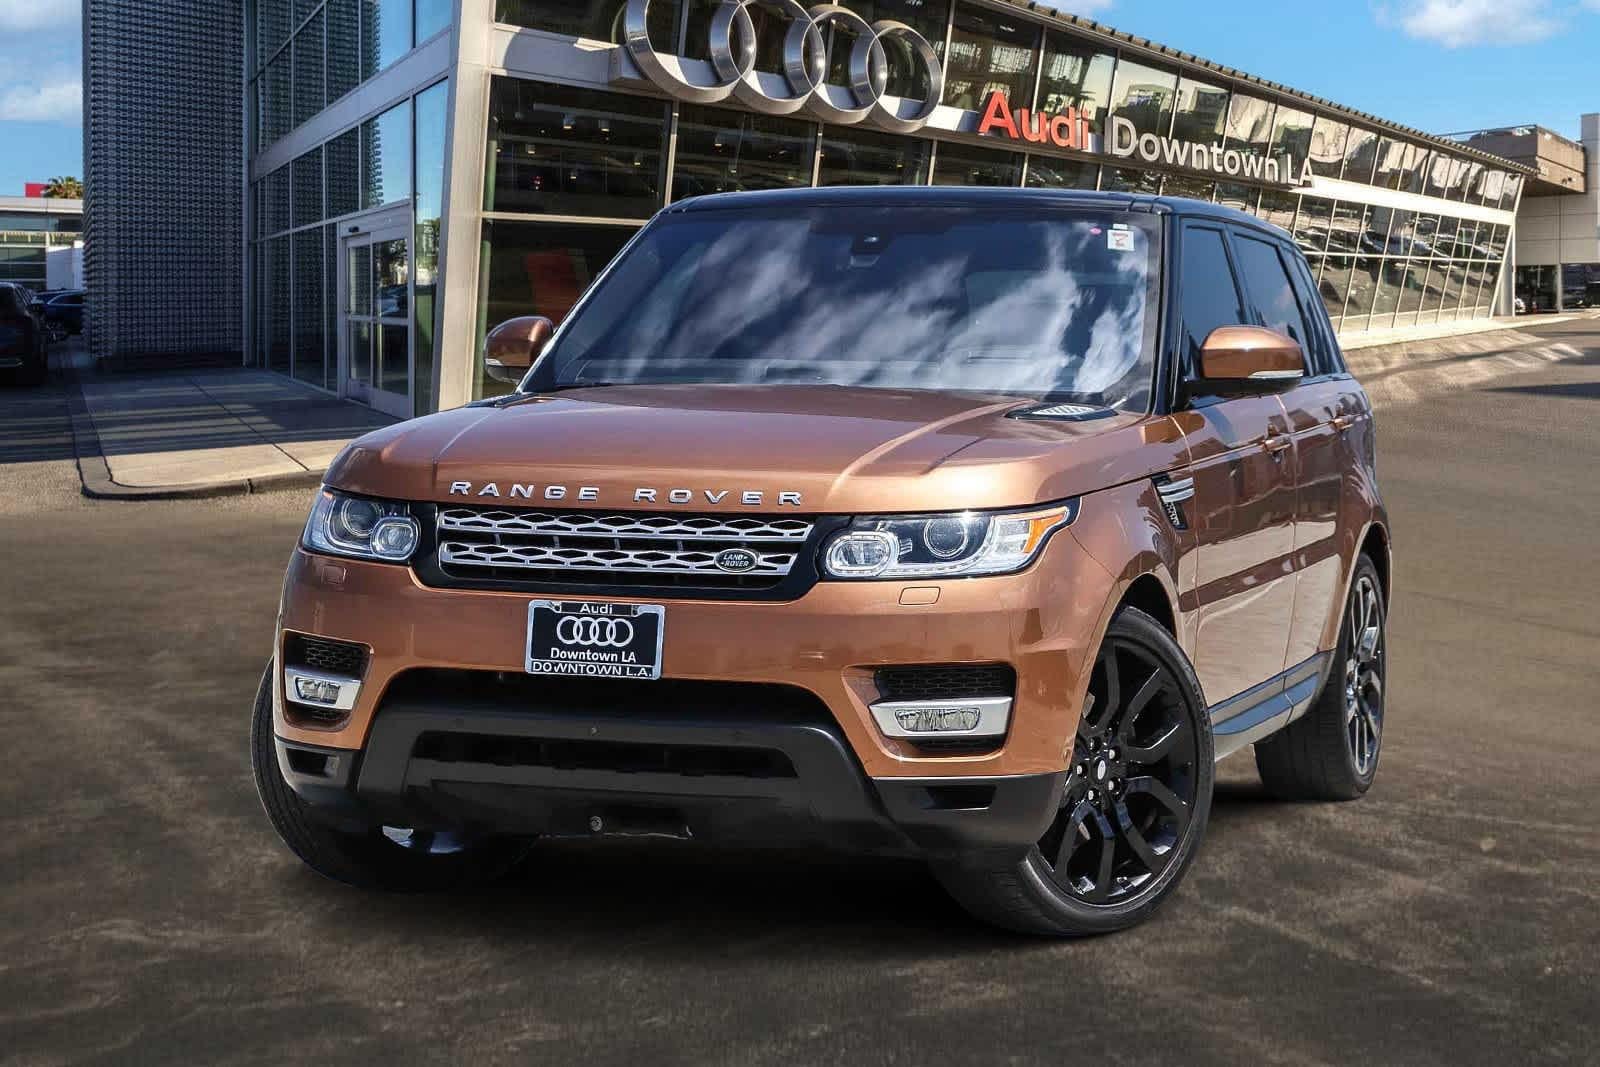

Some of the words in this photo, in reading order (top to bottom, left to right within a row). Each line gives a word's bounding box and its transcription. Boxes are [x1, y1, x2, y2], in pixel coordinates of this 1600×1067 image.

[978, 90, 1090, 150] Audi
[1105, 115, 1281, 183] Downtown
[1283, 153, 1316, 188] LA
[449, 481, 600, 502] RANGE
[633, 487, 803, 506] ROVER
[579, 603, 613, 615] Audi
[550, 647, 618, 662] Downtown
[621, 650, 637, 663] LA
[532, 661, 622, 676] DOWNTOWN
[626, 667, 652, 677] L.A.
